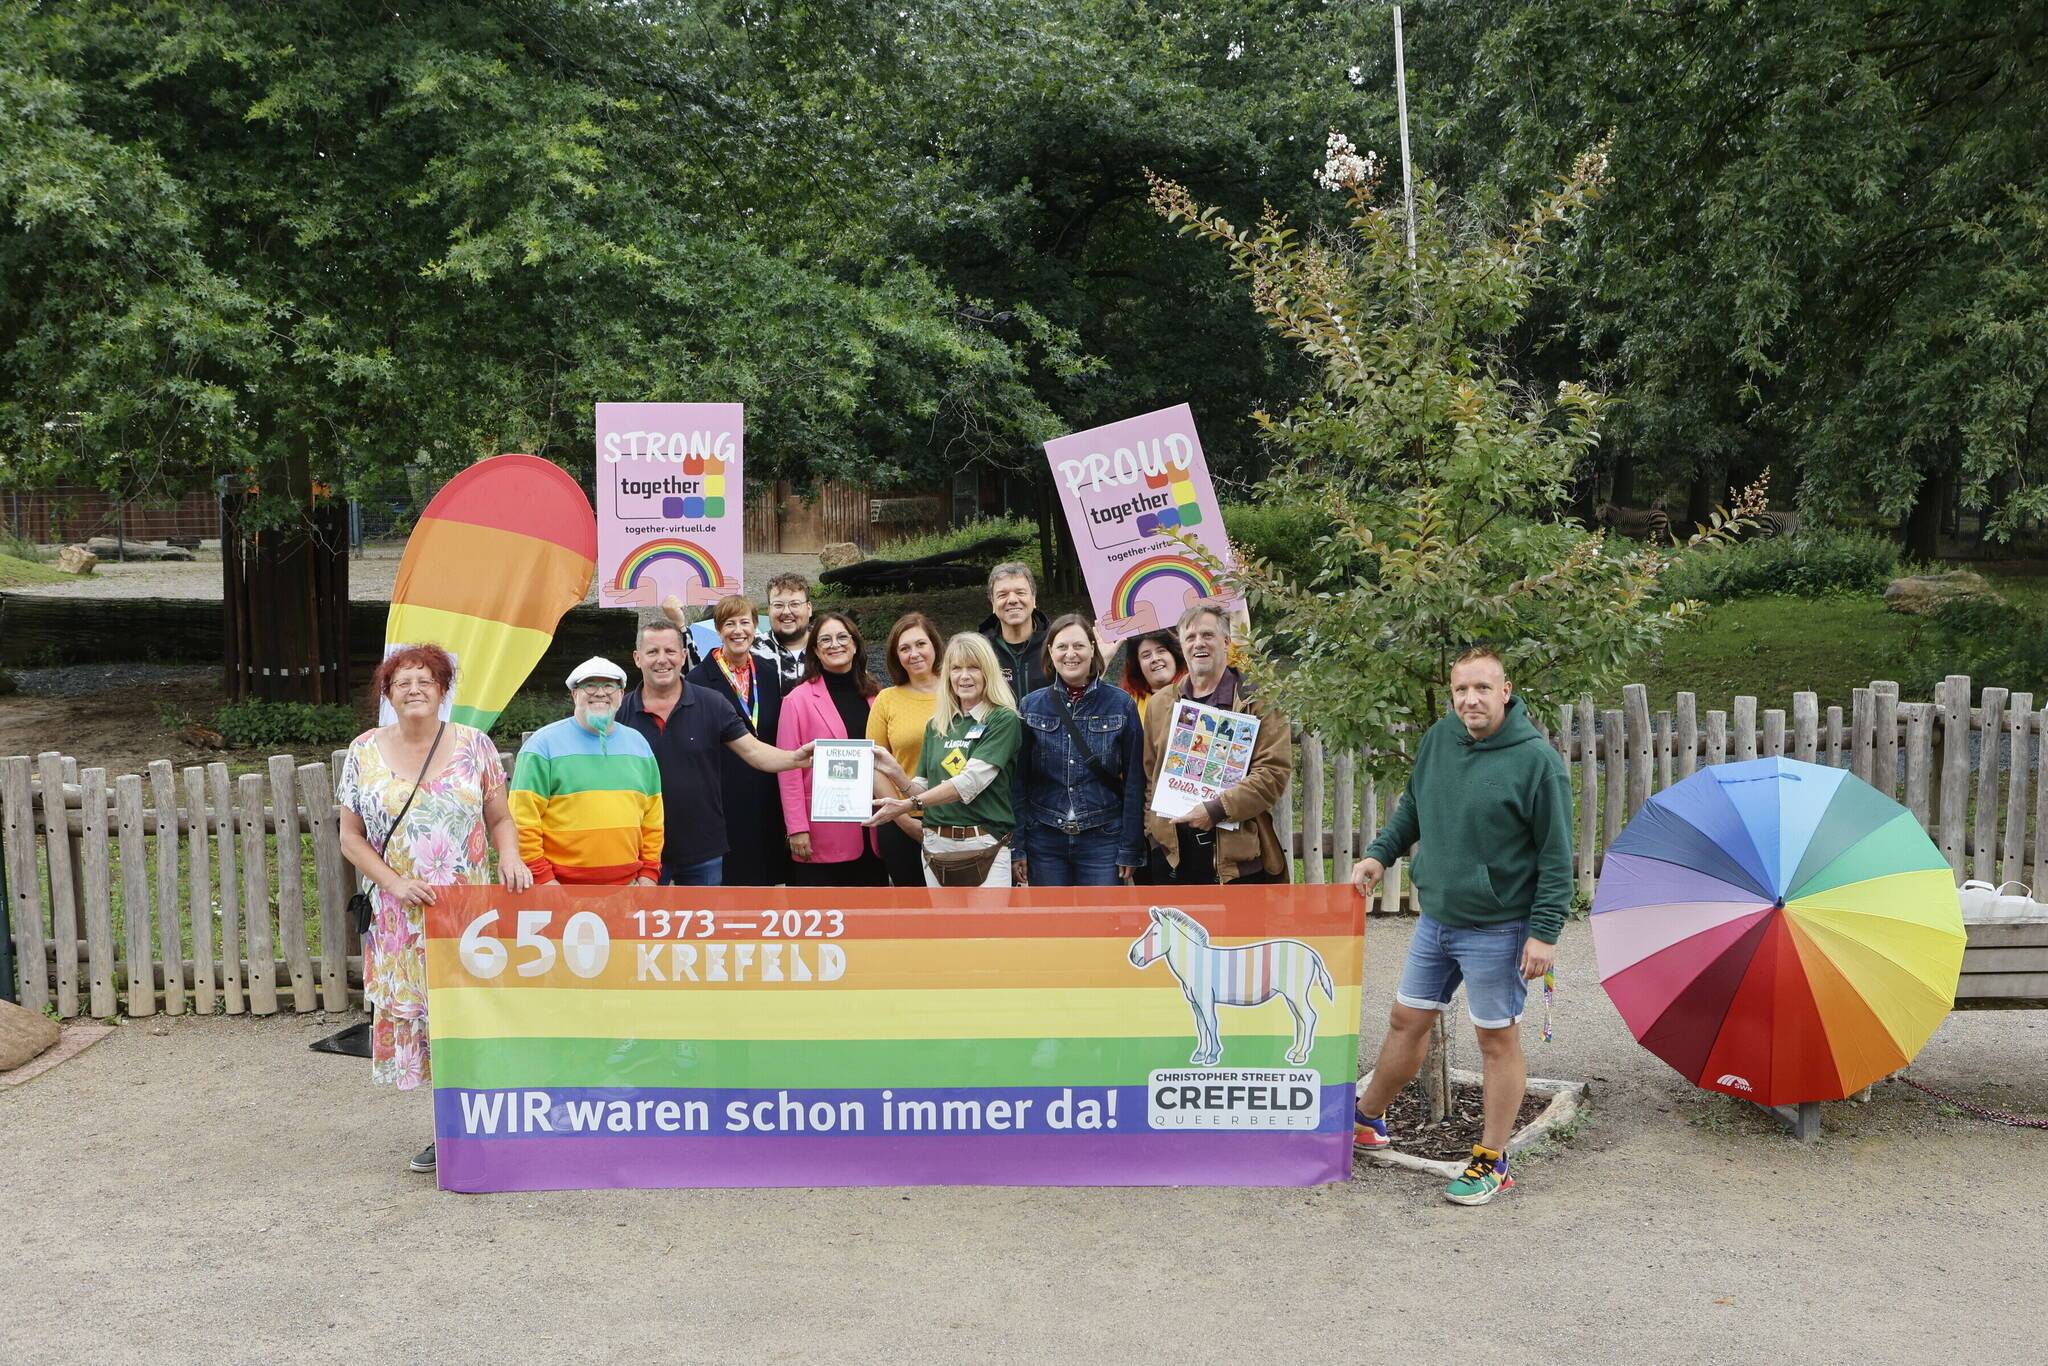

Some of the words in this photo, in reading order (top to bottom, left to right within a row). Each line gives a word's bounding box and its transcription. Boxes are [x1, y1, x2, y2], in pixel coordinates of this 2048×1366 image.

[603, 430, 737, 464] STRONG
[1057, 432, 1194, 498] PROUD
[621, 475, 700, 499] together
[1090, 492, 1169, 525] together
[625, 523, 717, 535] together-virtuell.de
[826, 748, 862, 758] URKUNDE
[1168, 777, 1200, 795] Wilde
[459, 908, 610, 979] 650
[637, 943, 847, 982] KREFELD
[1155, 1072, 1238, 1082] CHRISTOPHER
[1242, 1073, 1286, 1082] STREET
[1289, 1074, 1313, 1083] DAY
[1155, 1086, 1314, 1111] CREFELD
[459, 1091, 553, 1135] WIR
[566, 1100, 709, 1132] waren
[725, 1090, 865, 1132] schon
[882, 1089, 1033, 1131] immer
[1046, 1088, 1118, 1130] da!
[1155, 1115, 1313, 1126] QUEERBEET
